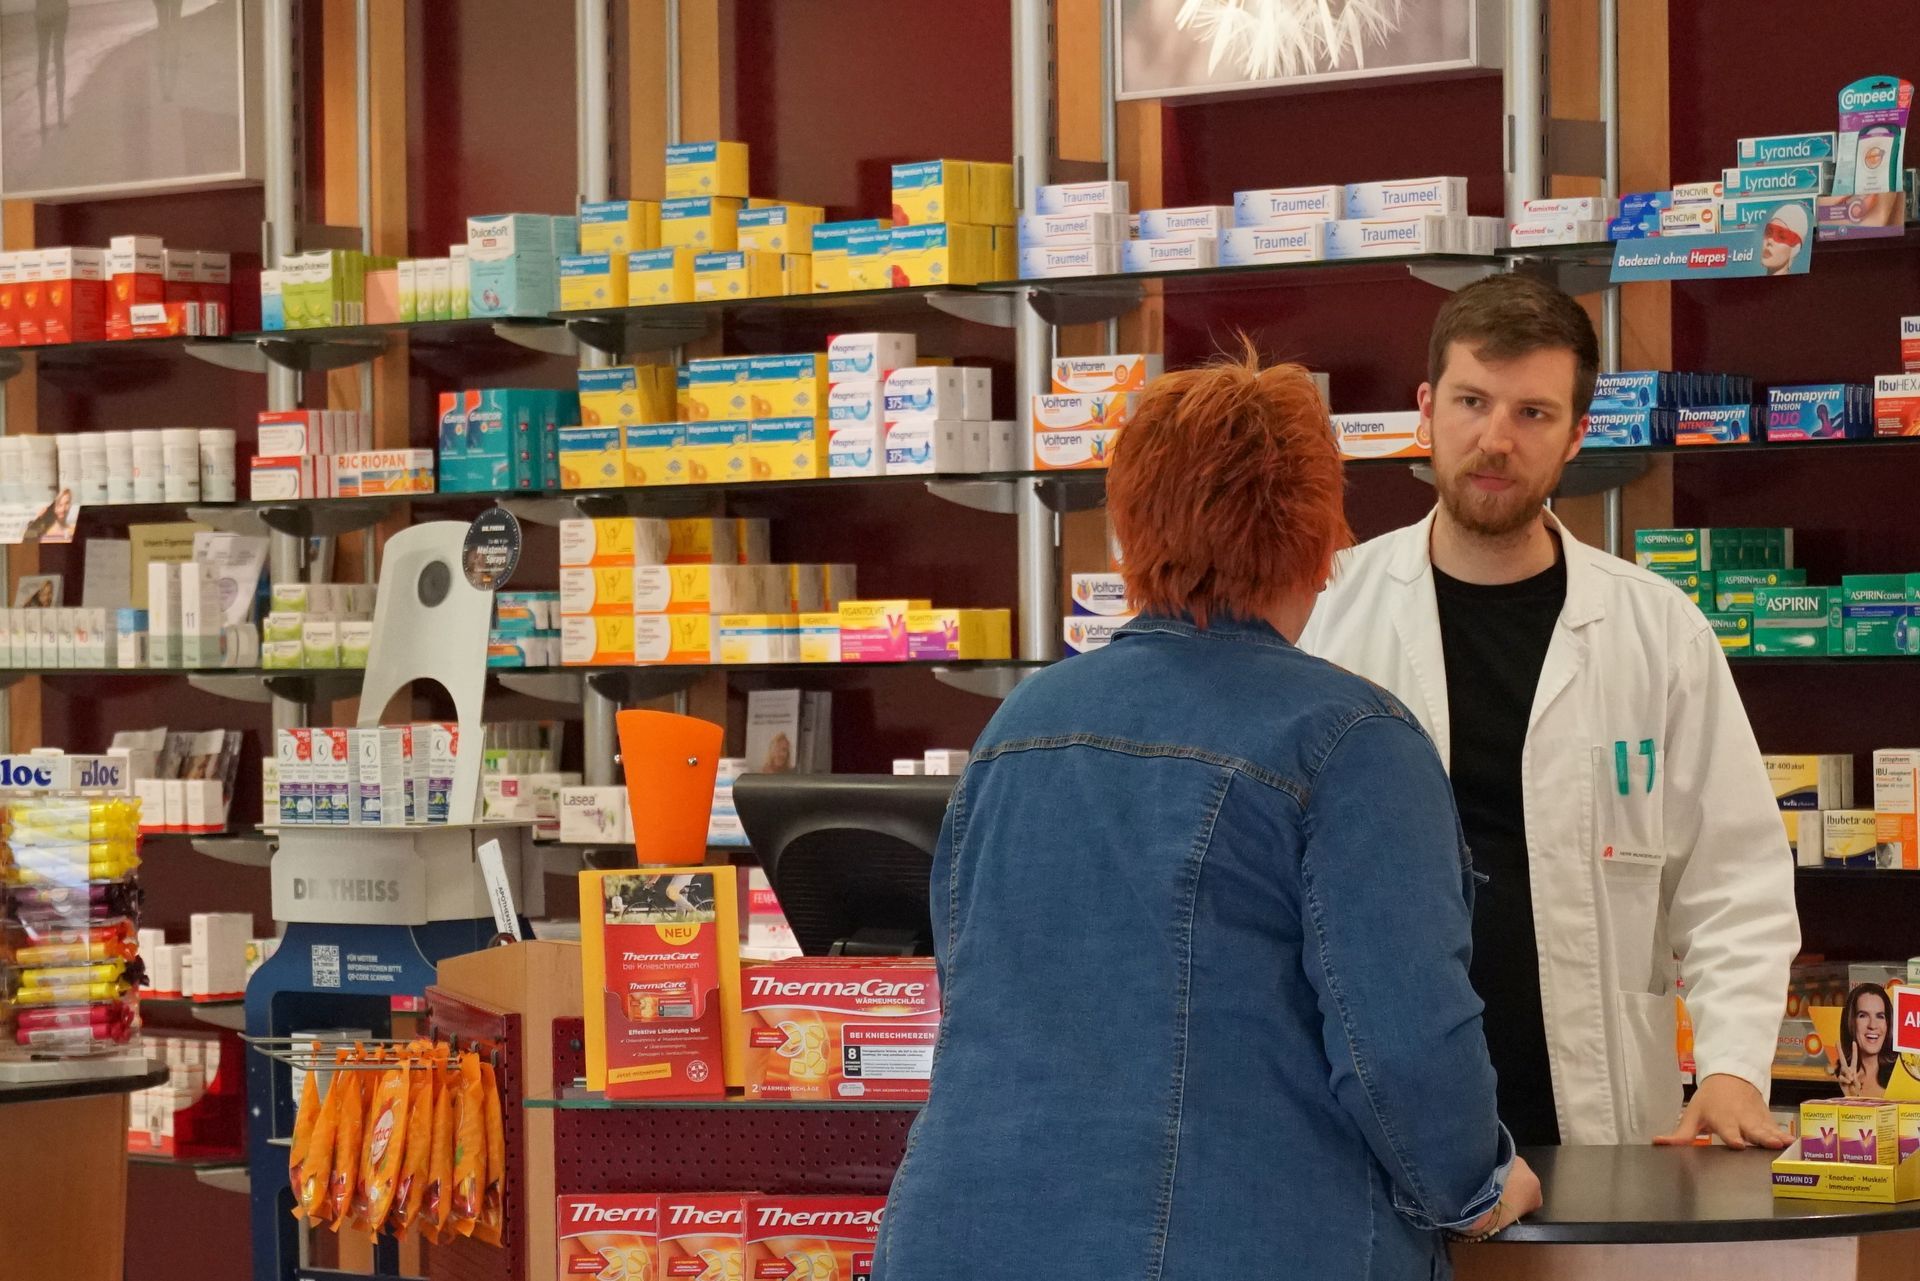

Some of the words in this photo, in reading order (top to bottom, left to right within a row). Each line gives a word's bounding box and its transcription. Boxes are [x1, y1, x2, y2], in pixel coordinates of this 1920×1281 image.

[1841, 88, 1896, 110] Compeed
[1760, 142, 1810, 160] Lyranda
[1745, 172, 1796, 192] Lyranda
[1063, 189, 1105, 203] Traumeel
[1382, 187, 1437, 205] Traumeel
[1271, 195, 1325, 213] Traumeel
[1045, 220, 1088, 234] Traumeel
[1166, 215, 1209, 228] Traumeel
[1361, 224, 1416, 242] Traumeel
[1253, 231, 1307, 249] Traumeel
[1150, 245, 1192, 258] Traumeel
[1046, 252, 1089, 265] Traumeel
[1618, 254, 1661, 267] Badezeit
[1663, 252, 1688, 265] ohne
[1690, 251, 1726, 266] Herpes
[1071, 361, 1106, 372] Voltaren
[1595, 374, 1653, 388] homapyrin
[1593, 386, 1620, 397] LASSIC
[1768, 388, 1840, 403] Thomapyrin
[887, 397, 903, 410] 375
[1041, 396, 1082, 409] Voltaren
[1770, 402, 1801, 411] TENSION
[1588, 411, 1645, 426] omapyrin
[1678, 408, 1746, 423] Thomapyrin
[1769, 411, 1800, 426] DUO
[1341, 421, 1385, 433] Voltaren
[1587, 423, 1610, 433] ASSIC
[1042, 434, 1082, 446] Voltaren
[361, 453, 406, 469] RIOPAN
[888, 451, 903, 462] 375
[1643, 535, 1672, 544] ASPIRIN
[1724, 576, 1753, 585] ASPIRIN
[1850, 590, 1883, 600] ASPIRIN
[1766, 596, 1819, 612] ASPIRIN
[1085, 624, 1117, 636] Voltar
[1777, 762, 1791, 770] 400
[563, 793, 596, 806] Lasea
[1826, 814, 1859, 826] Ibubeta
[1861, 817, 1876, 825] 400
[328, 878, 400, 902] THEISS
[664, 927, 692, 938] NEU
[622, 952, 700, 961] ThermaCare
[622, 962, 636, 970] bei
[637, 961, 700, 970] Knieschmerzen
[629, 981, 687, 990] ThermaCare
[750, 976, 925, 997] ThermaCare
[628, 1028, 657, 1036] Effektive
[657, 1027, 689, 1036] Linderung
[865, 1032, 935, 1040] KNIESCHMERZEN
[847, 1047, 857, 1060] 8
[751, 1083, 759, 1093] 2
[1804, 1151, 1824, 1159] Vitamin
[1843, 1153, 1863, 1161] Vitamin
[1775, 1175, 1802, 1184] VITAMIN
[1803, 1176, 1813, 1185] D3
